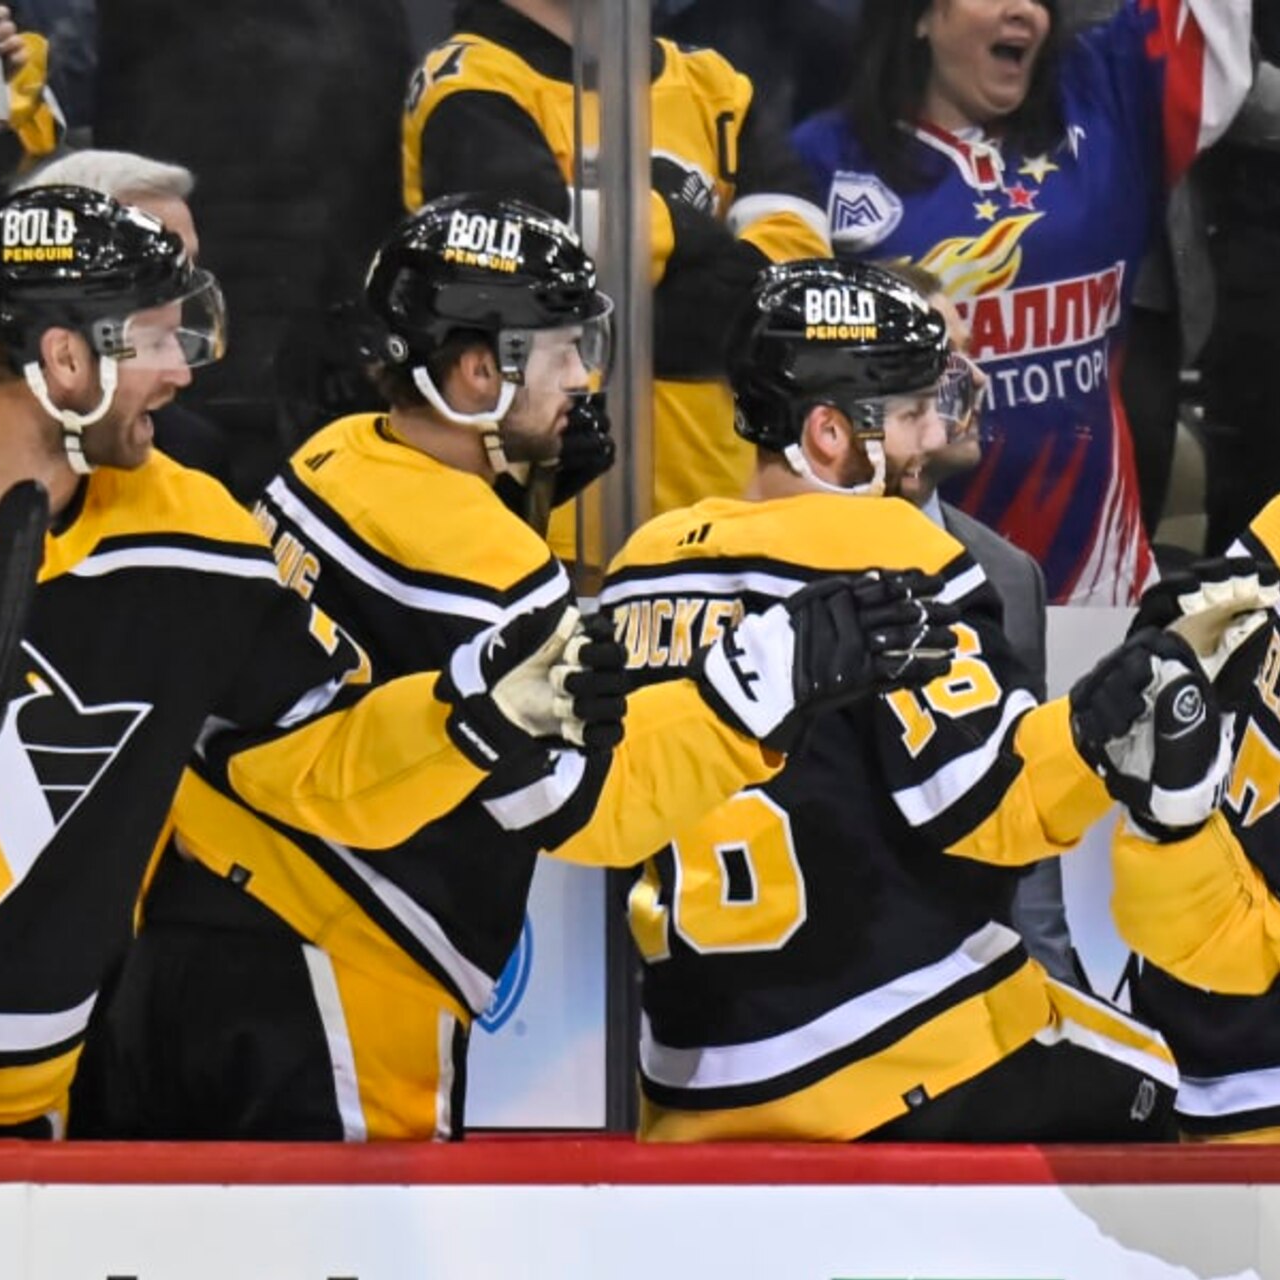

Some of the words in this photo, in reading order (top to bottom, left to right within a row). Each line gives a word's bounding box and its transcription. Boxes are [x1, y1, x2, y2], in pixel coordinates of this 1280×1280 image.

[3, 208, 77, 246] BOLD
[447, 210, 522, 259] BOLD
[3, 246, 74, 262] PENGUIN
[444, 248, 518, 273] PENUIN
[805, 286, 876, 324] BOLD
[805, 325, 877, 341] PENGUIN
